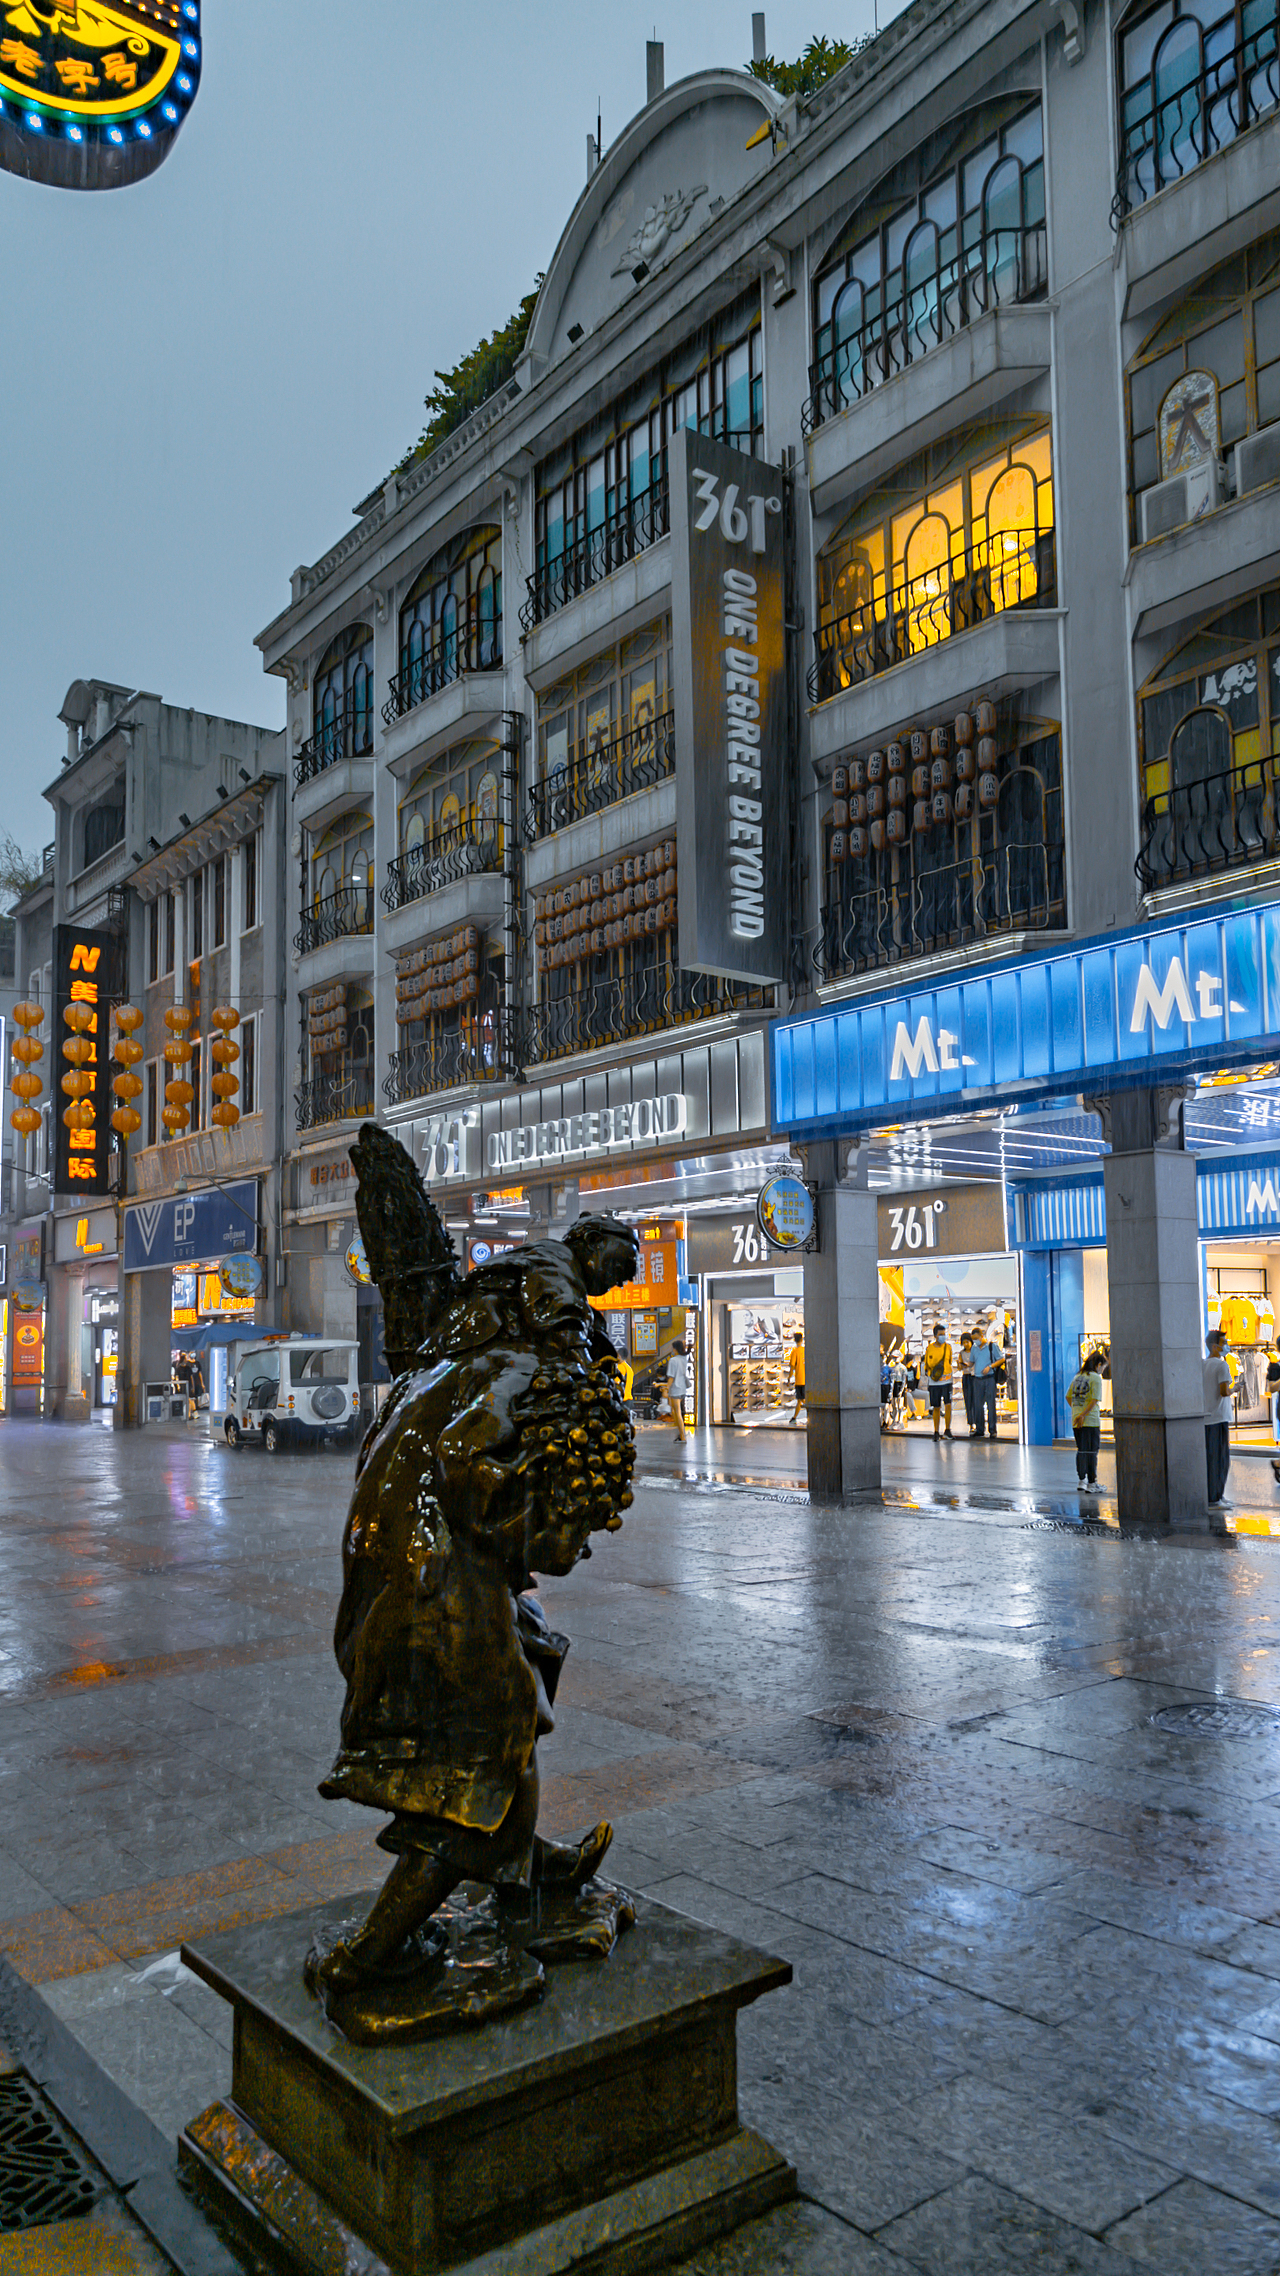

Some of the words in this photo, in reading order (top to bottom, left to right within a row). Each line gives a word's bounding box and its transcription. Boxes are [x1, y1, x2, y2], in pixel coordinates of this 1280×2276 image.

[0, 38, 138, 94] 老字号
[691, 467, 782, 554] 361°
[723, 568, 759, 645] ONE
[724, 646, 762, 792] DEGREE
[728, 794, 766, 940] BEYOND
[1130, 956, 1248, 1033] Mt.
[890, 1015, 978, 1081] Mt.
[420, 1110, 480, 1182] 361°
[487, 1126, 525, 1168] ONE
[523, 1112, 600, 1160] DEGREE
[600, 1092, 688, 1147] BEYOND
[174, 1202, 196, 1242] EP
[888, 1199, 947, 1250] 361°
[1246, 1179, 1280, 1213] M
[622, 1250, 664, 1285] 眼镜
[611, 1313, 626, 1349] 联合大
